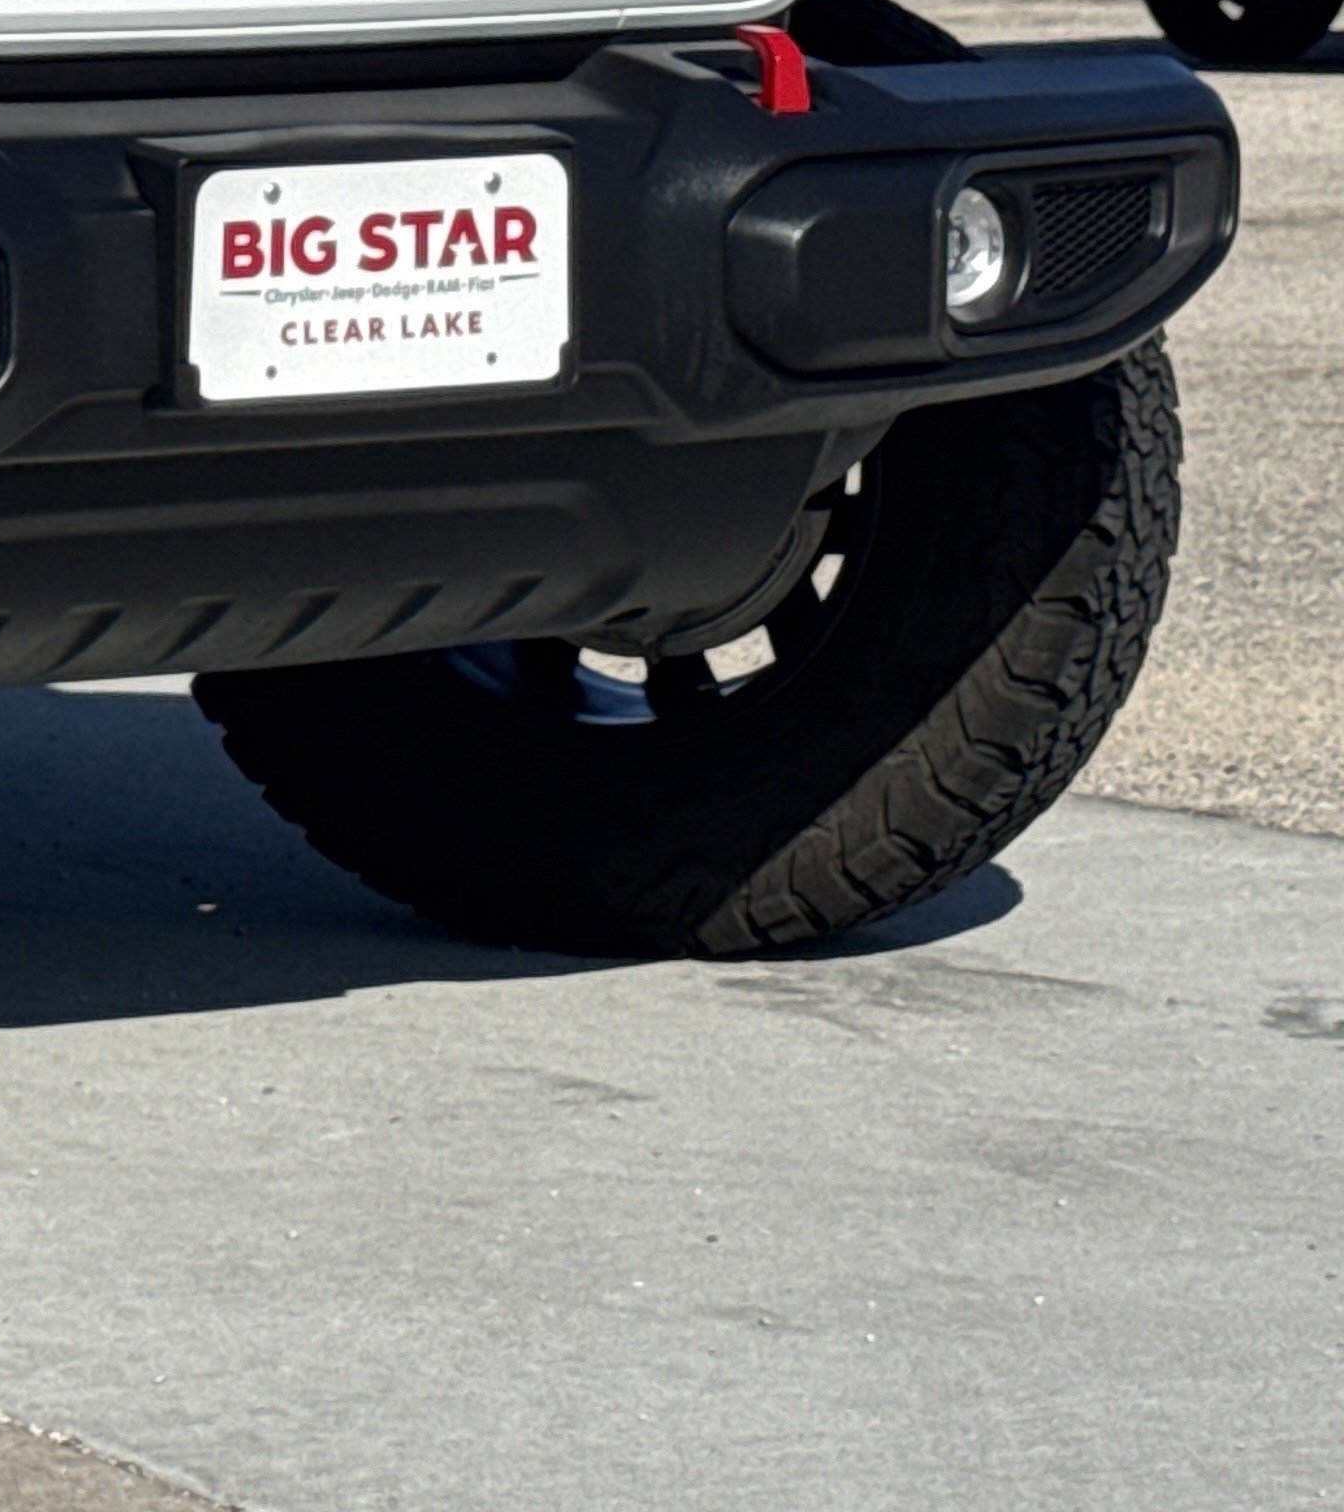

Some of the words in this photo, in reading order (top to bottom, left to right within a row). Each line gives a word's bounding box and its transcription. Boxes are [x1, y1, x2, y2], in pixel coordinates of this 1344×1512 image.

[220, 215, 338, 280] BIG
[357, 205, 539, 273] STAR
[280, 316, 386, 346] CLEAR
[400, 310, 483, 339] LAKE
